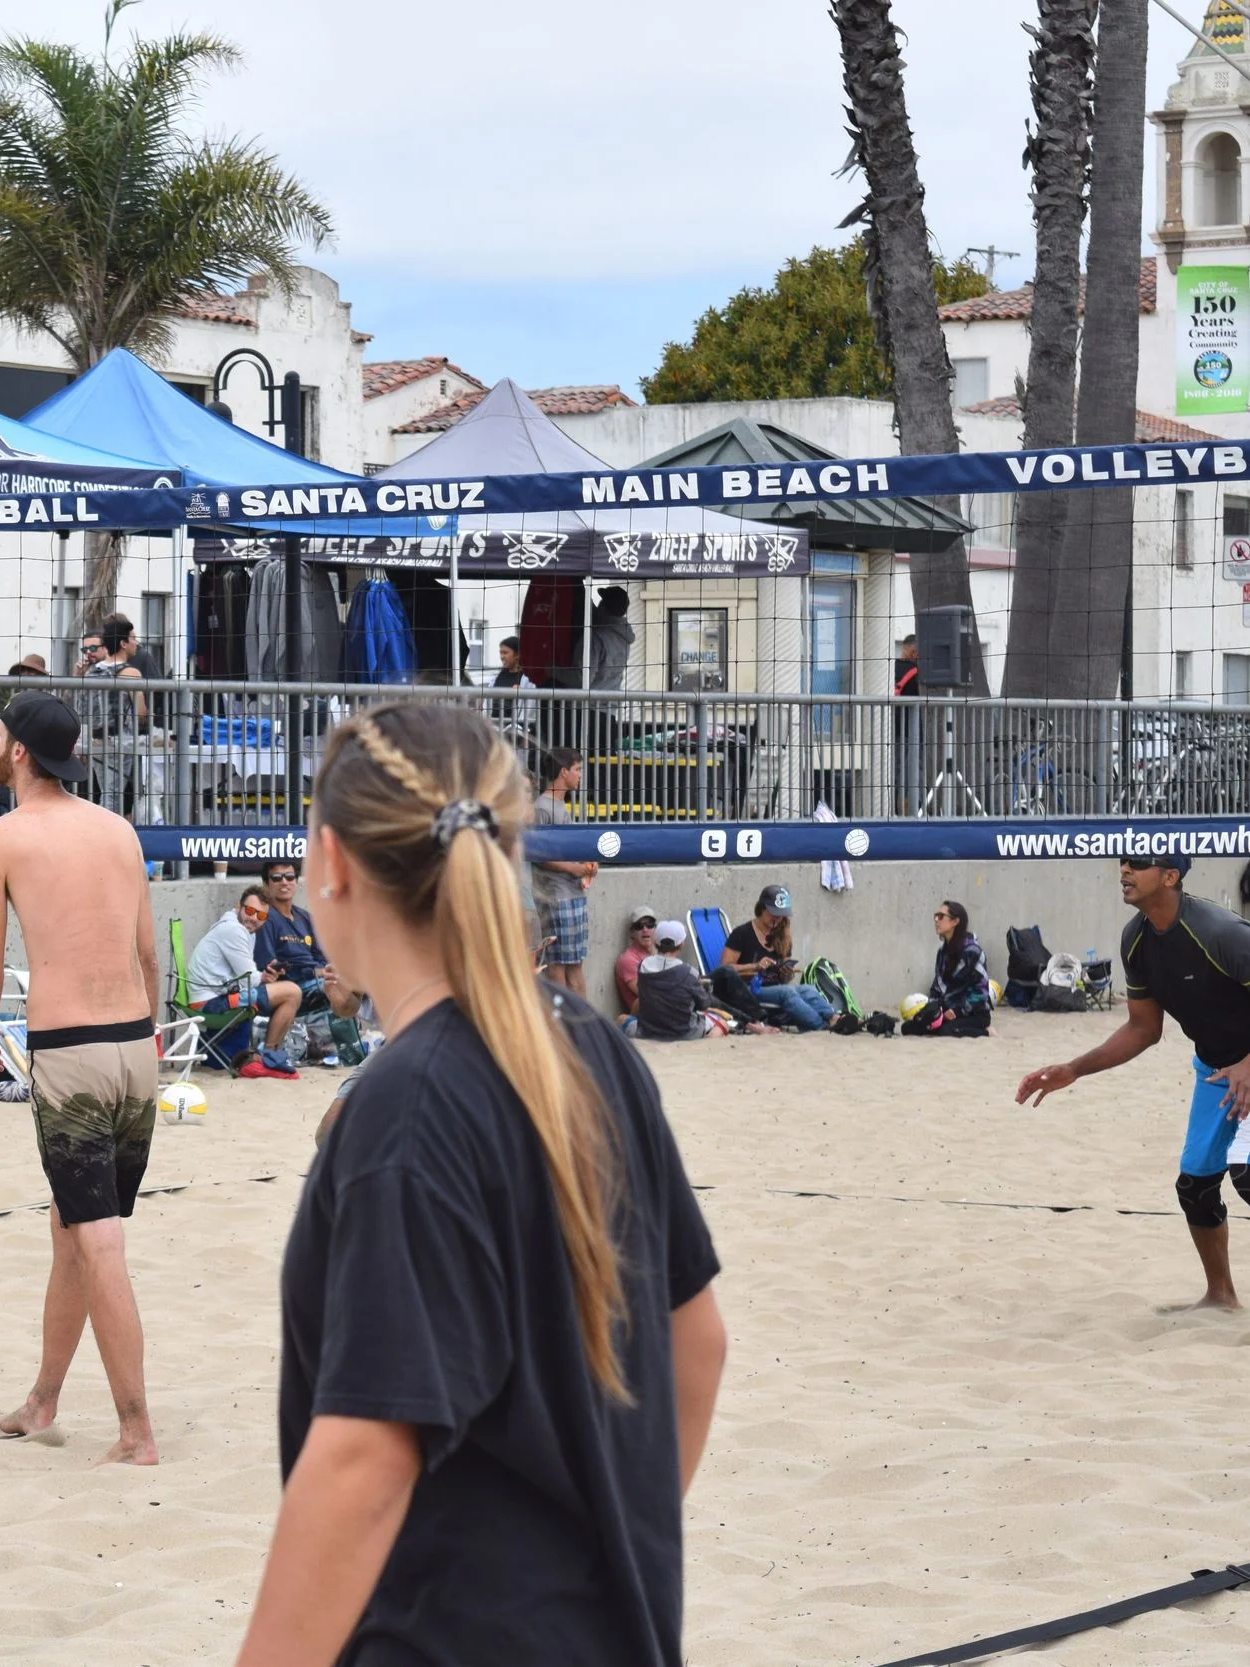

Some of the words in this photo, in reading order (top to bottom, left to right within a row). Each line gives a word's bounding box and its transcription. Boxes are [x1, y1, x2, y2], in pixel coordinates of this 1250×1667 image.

[1193, 295, 1236, 314] 150
[1190, 315, 1234, 328] Years
[1188, 329, 1238, 339] Creating
[1189, 341, 1238, 349] Community
[1005, 446, 1247, 484] VOLLEYB
[241, 487, 367, 516] SANTA
[376, 482, 485, 512] CRUZ
[581, 472, 699, 503] MAIN
[721, 463, 889, 498] BEACH
[703, 532, 758, 562] SPORTS
[680, 651, 717, 662] CHANGE
